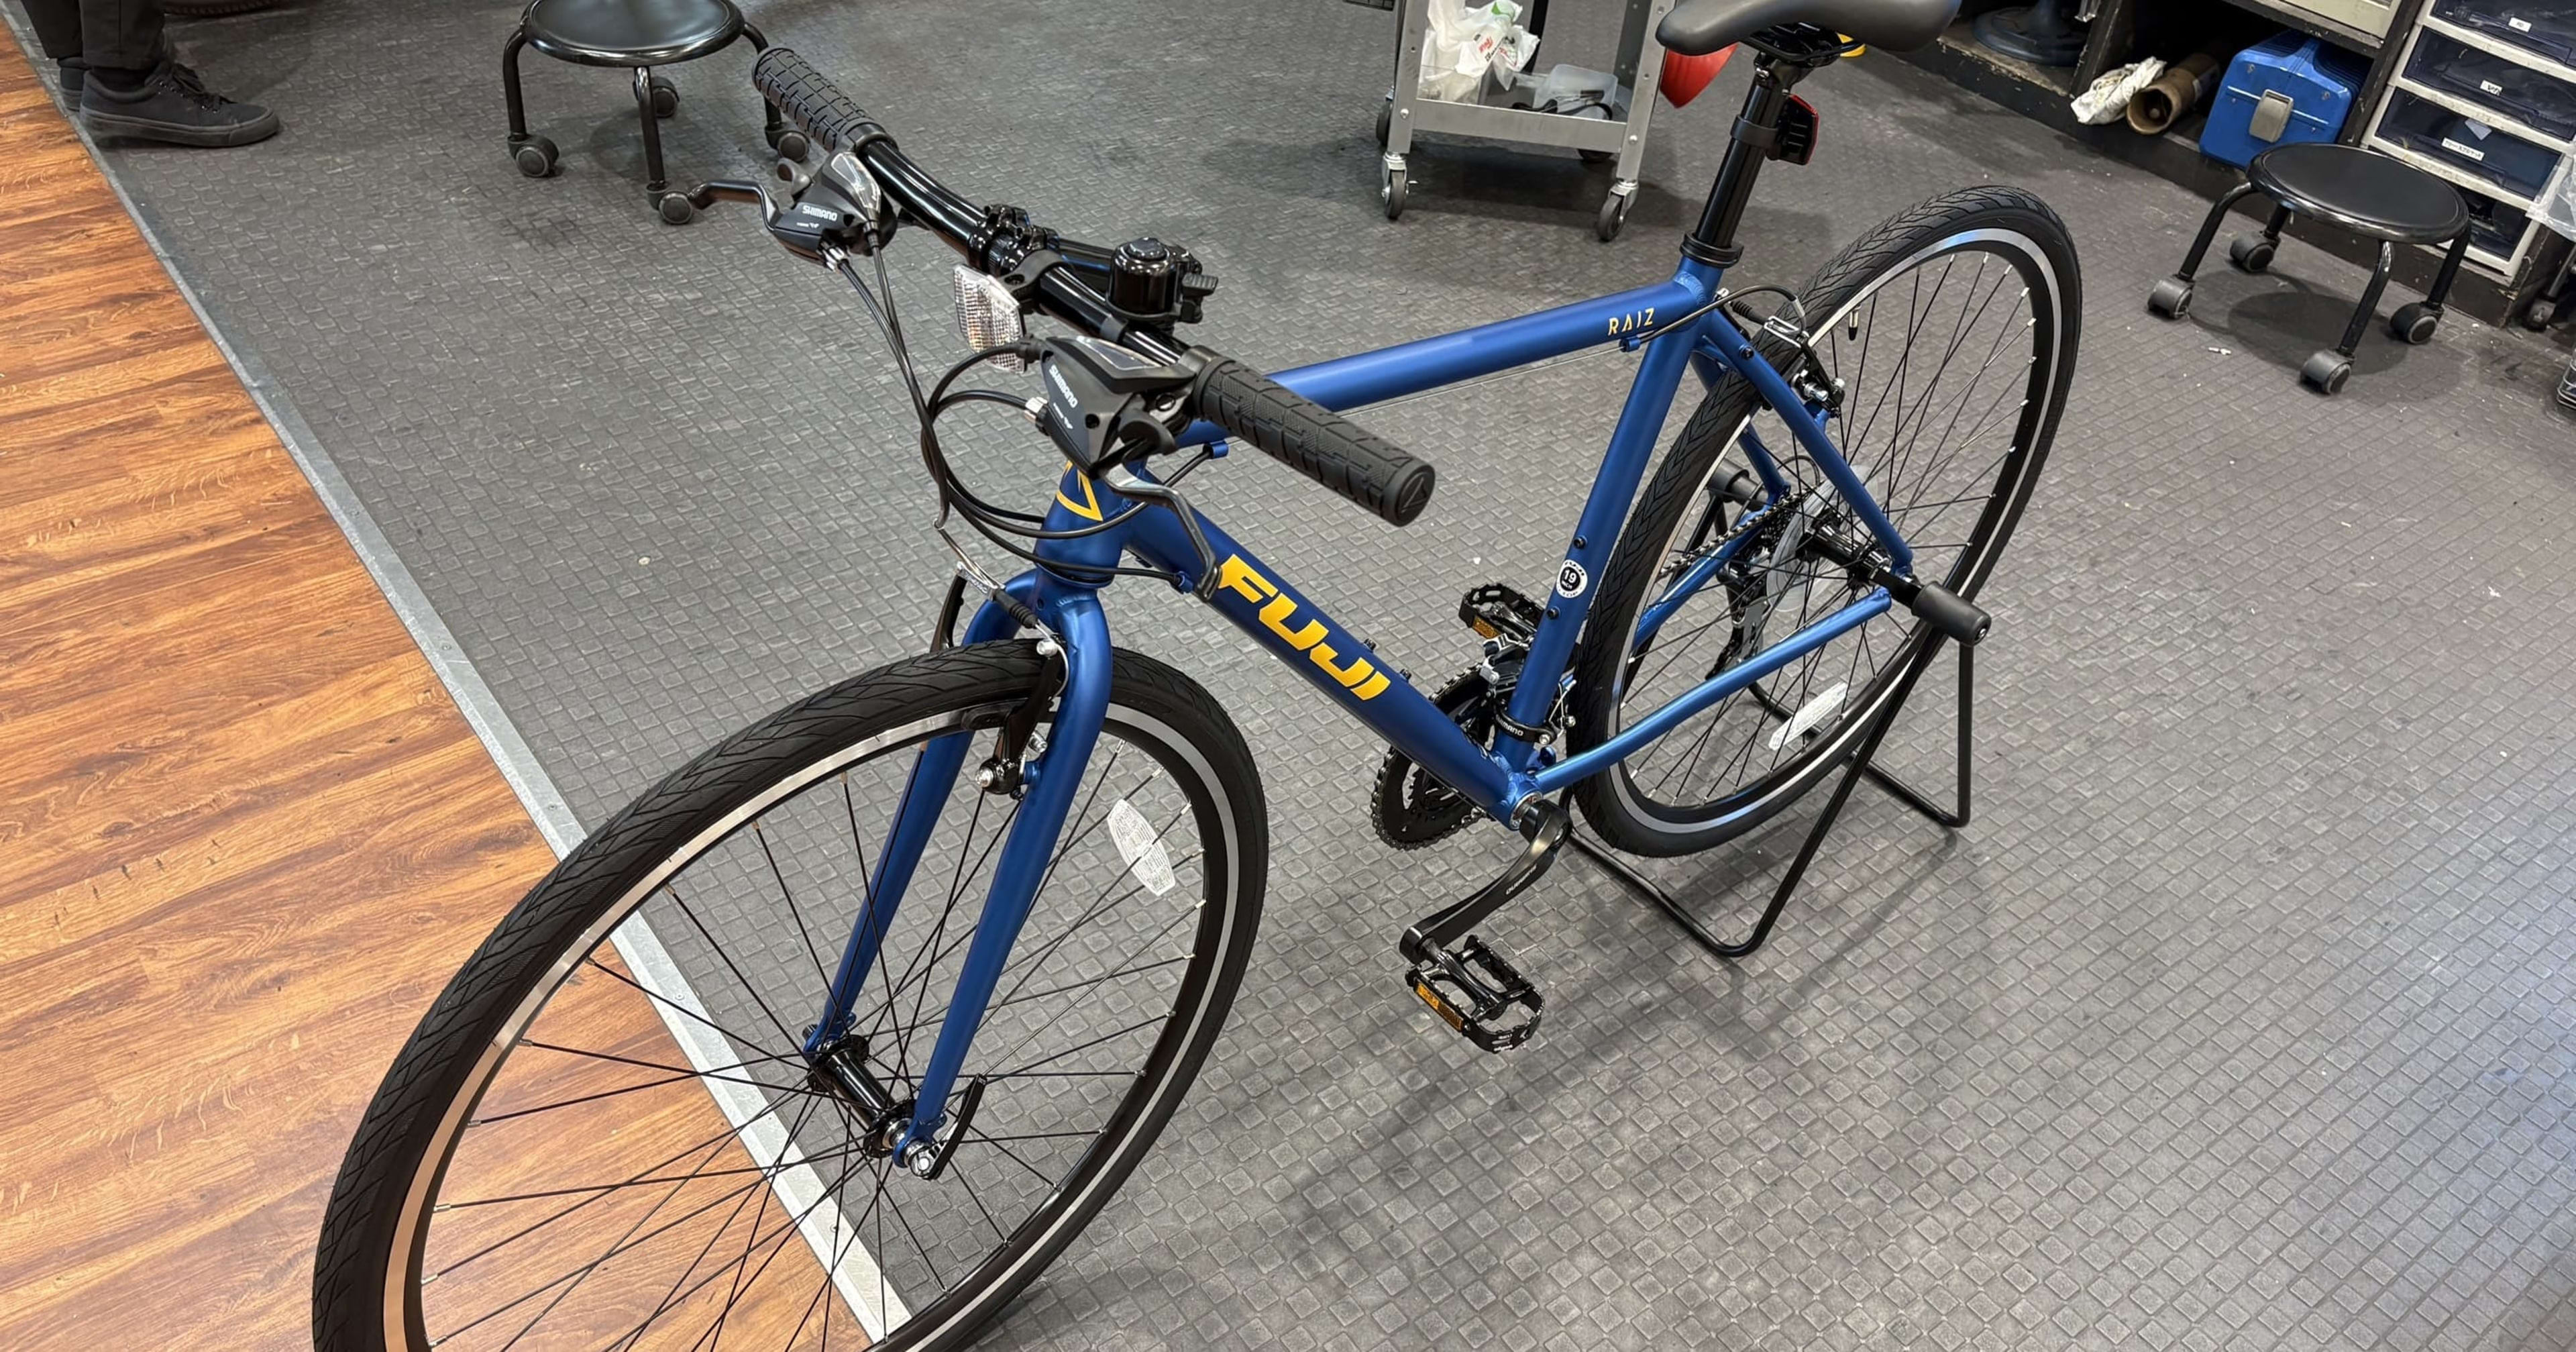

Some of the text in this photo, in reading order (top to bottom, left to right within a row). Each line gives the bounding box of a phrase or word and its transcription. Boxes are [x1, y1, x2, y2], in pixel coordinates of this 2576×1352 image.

[802, 205, 838, 221] SHIMANO
[1607, 307, 1655, 336] RAIZ
[1049, 364, 1078, 409] SHIMANO
[1564, 569, 1577, 584] 19
[1218, 554, 1391, 701] FUJI
